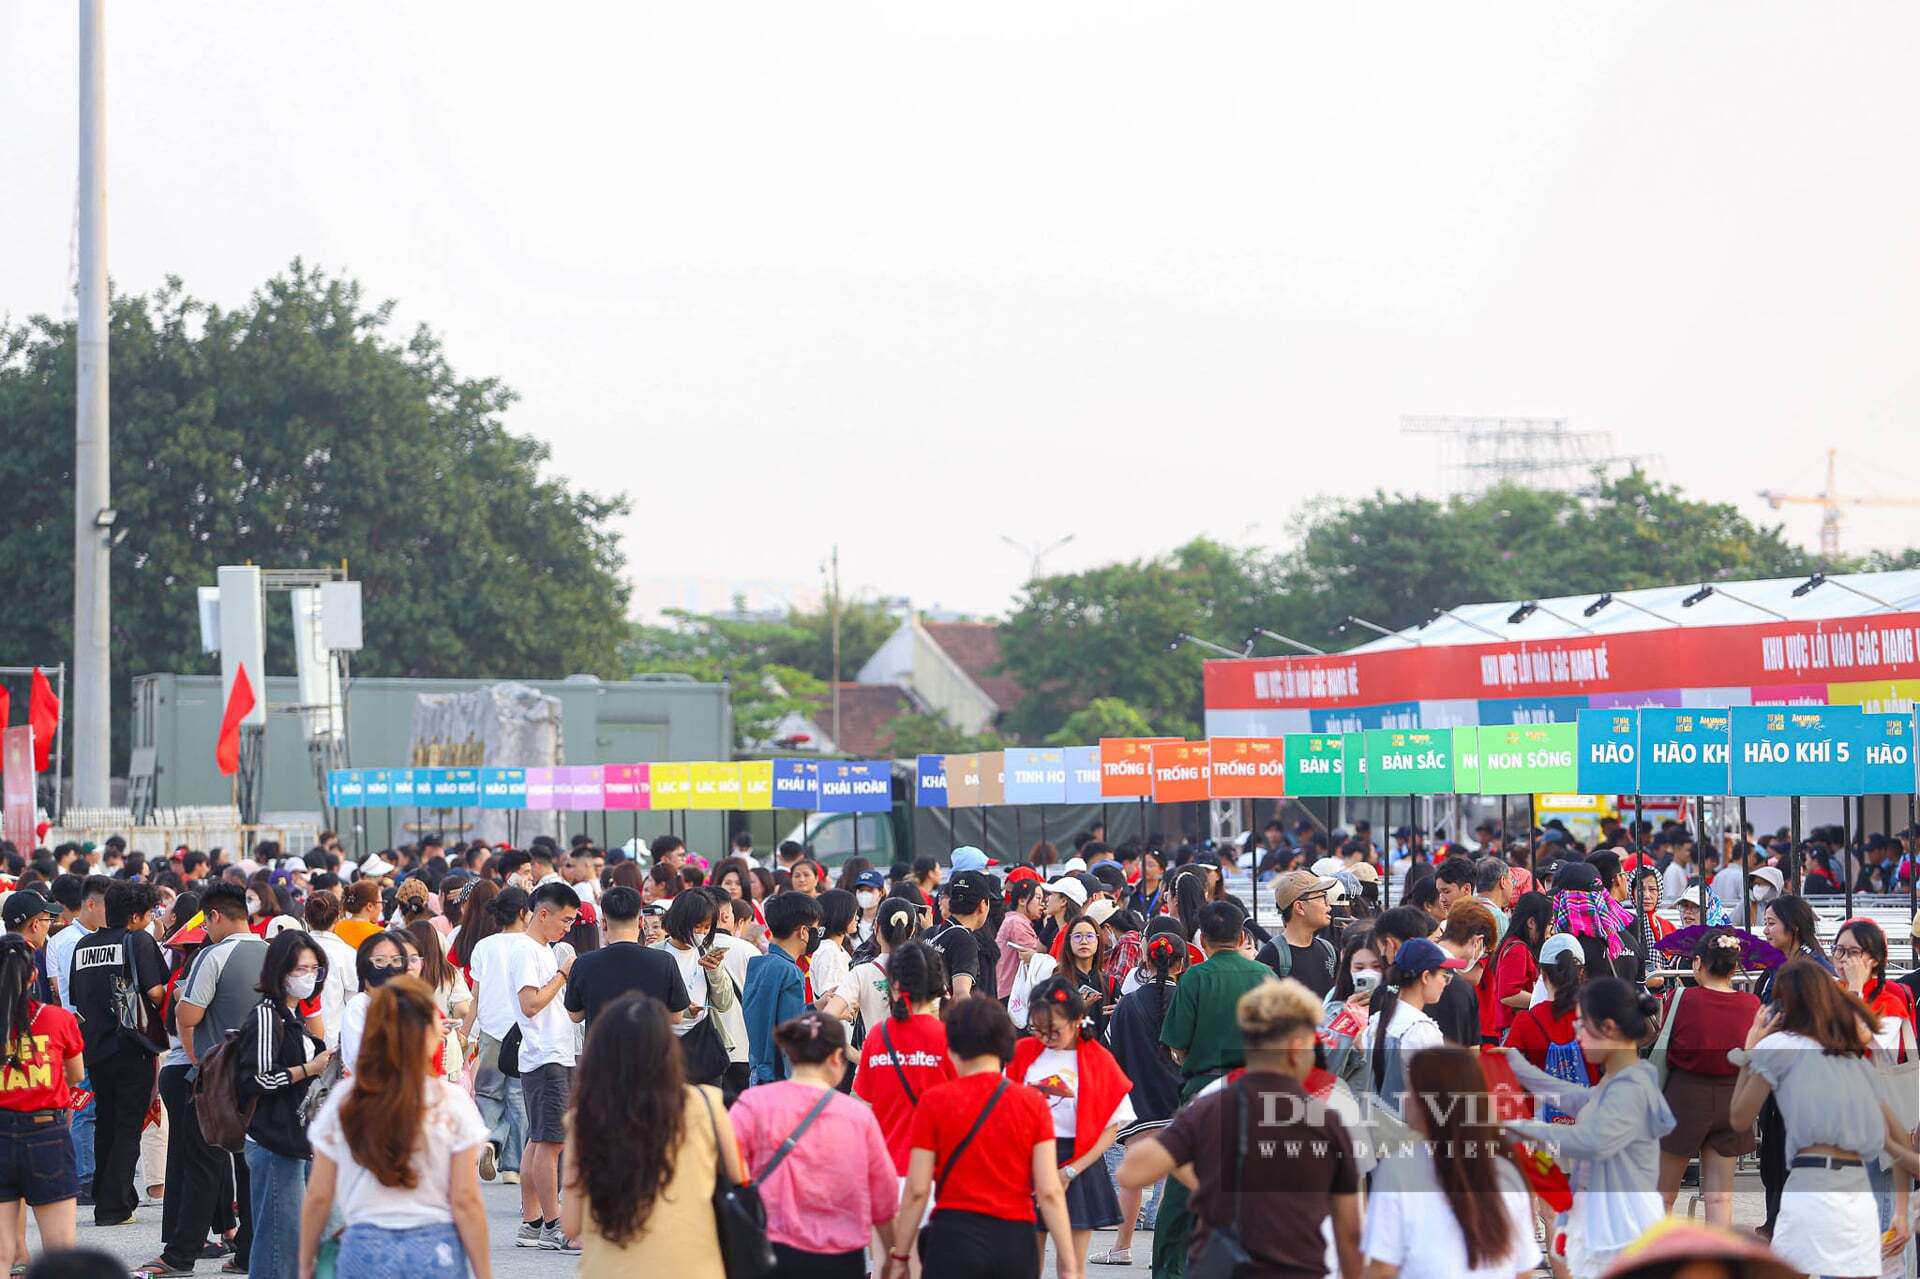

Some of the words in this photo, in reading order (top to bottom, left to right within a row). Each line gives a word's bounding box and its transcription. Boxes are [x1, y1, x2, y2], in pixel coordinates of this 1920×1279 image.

[1762, 636, 1784, 671] KHU
[1785, 632, 1808, 676] VỰC
[1810, 621, 1829, 669] LỐI
[1831, 626, 1854, 667] VÀO
[1856, 624, 1880, 666] CÁC
[1881, 628, 1914, 671] HẠNG
[1382, 752, 1413, 770] BẢN
[1417, 749, 1446, 770] SẮC
[1488, 752, 1522, 769] NON
[1527, 748, 1571, 769] SÔNG
[1591, 739, 1635, 763] HÀO
[1653, 740, 1697, 763] HÀO
[1702, 743, 1728, 763] KH
[1744, 738, 1790, 763] HÀO
[1796, 738, 1832, 763] KHÍ
[1837, 742, 1850, 763] 5
[1866, 743, 1907, 764] HÀO
[1103, 759, 1144, 776] TRỐNG
[1156, 764, 1198, 781] TRỐNG
[1214, 759, 1255, 776] TRỐNG
[1300, 755, 1330, 774] BẢN
[1333, 758, 1342, 773] S
[1015, 770, 1043, 784] TINH
[1046, 769, 1065, 784] HO
[82, 946, 115, 966] UNION
